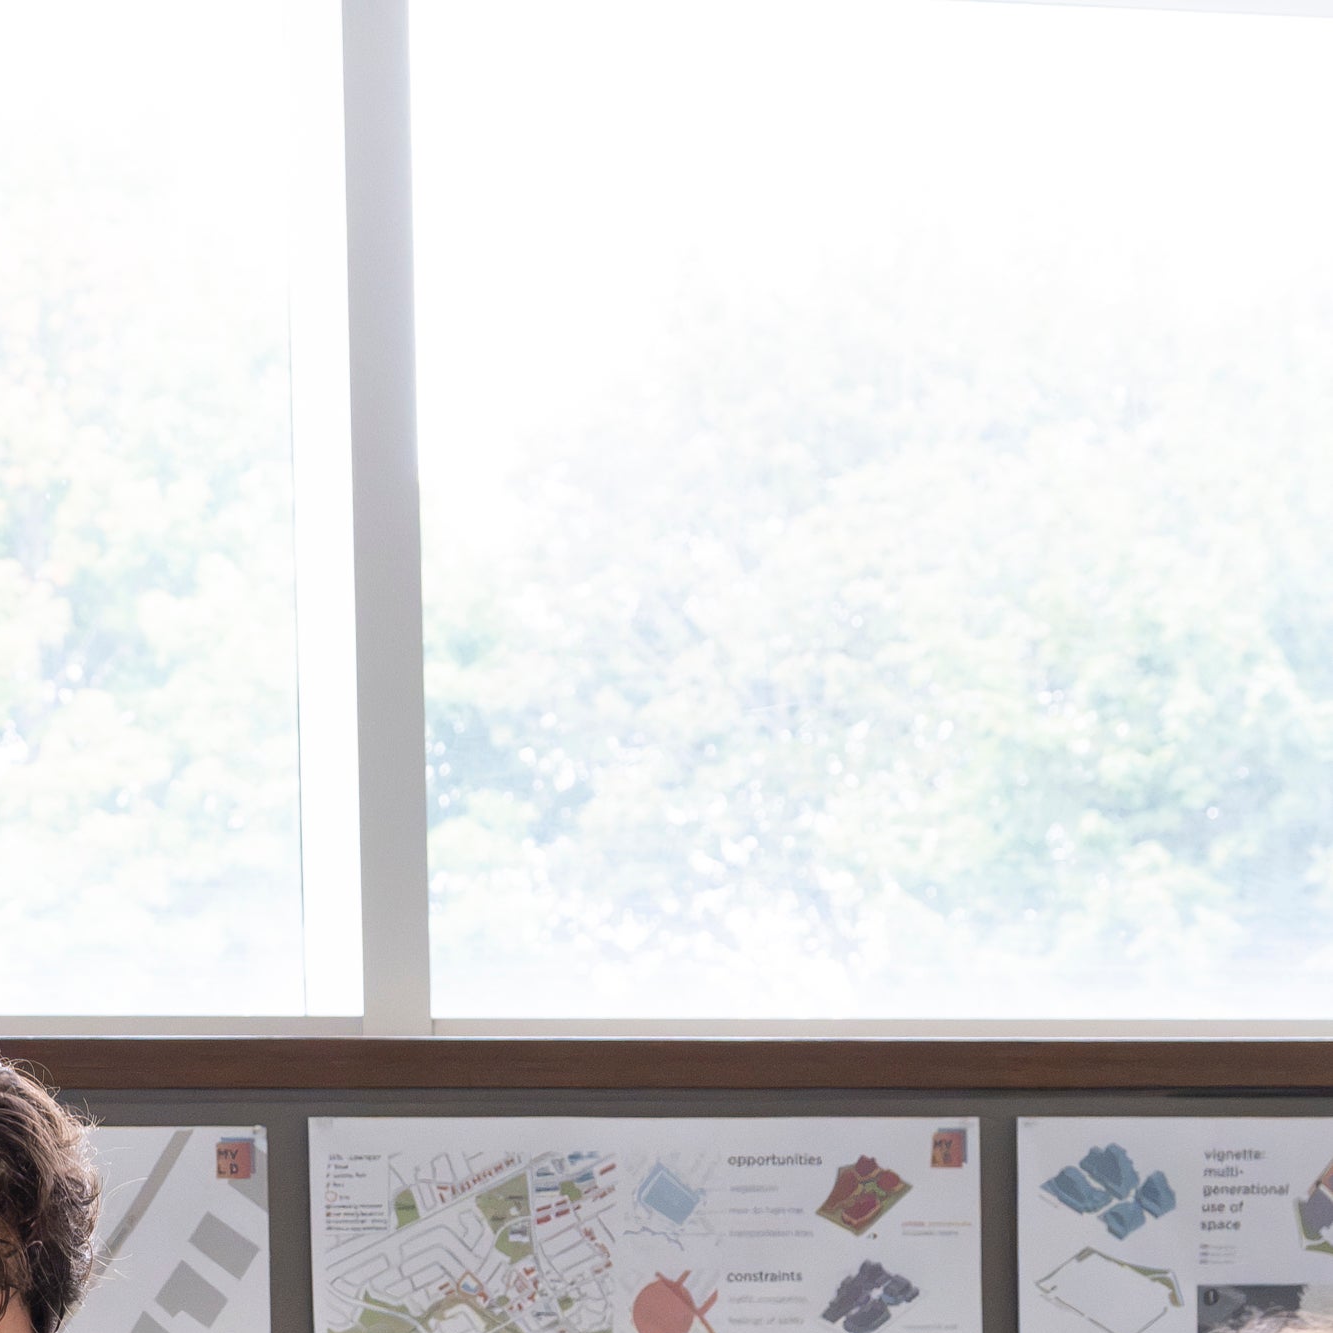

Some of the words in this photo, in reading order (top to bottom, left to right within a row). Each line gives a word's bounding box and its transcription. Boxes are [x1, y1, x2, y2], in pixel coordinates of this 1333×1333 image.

[727, 1153, 823, 1168] opportunities
[1202, 1183, 1290, 1198] generational
[1201, 1202, 1226, 1213] use
[1230, 1200, 1244, 1213] of
[1200, 1219, 1241, 1232] space
[726, 1269, 803, 1283] constraints
